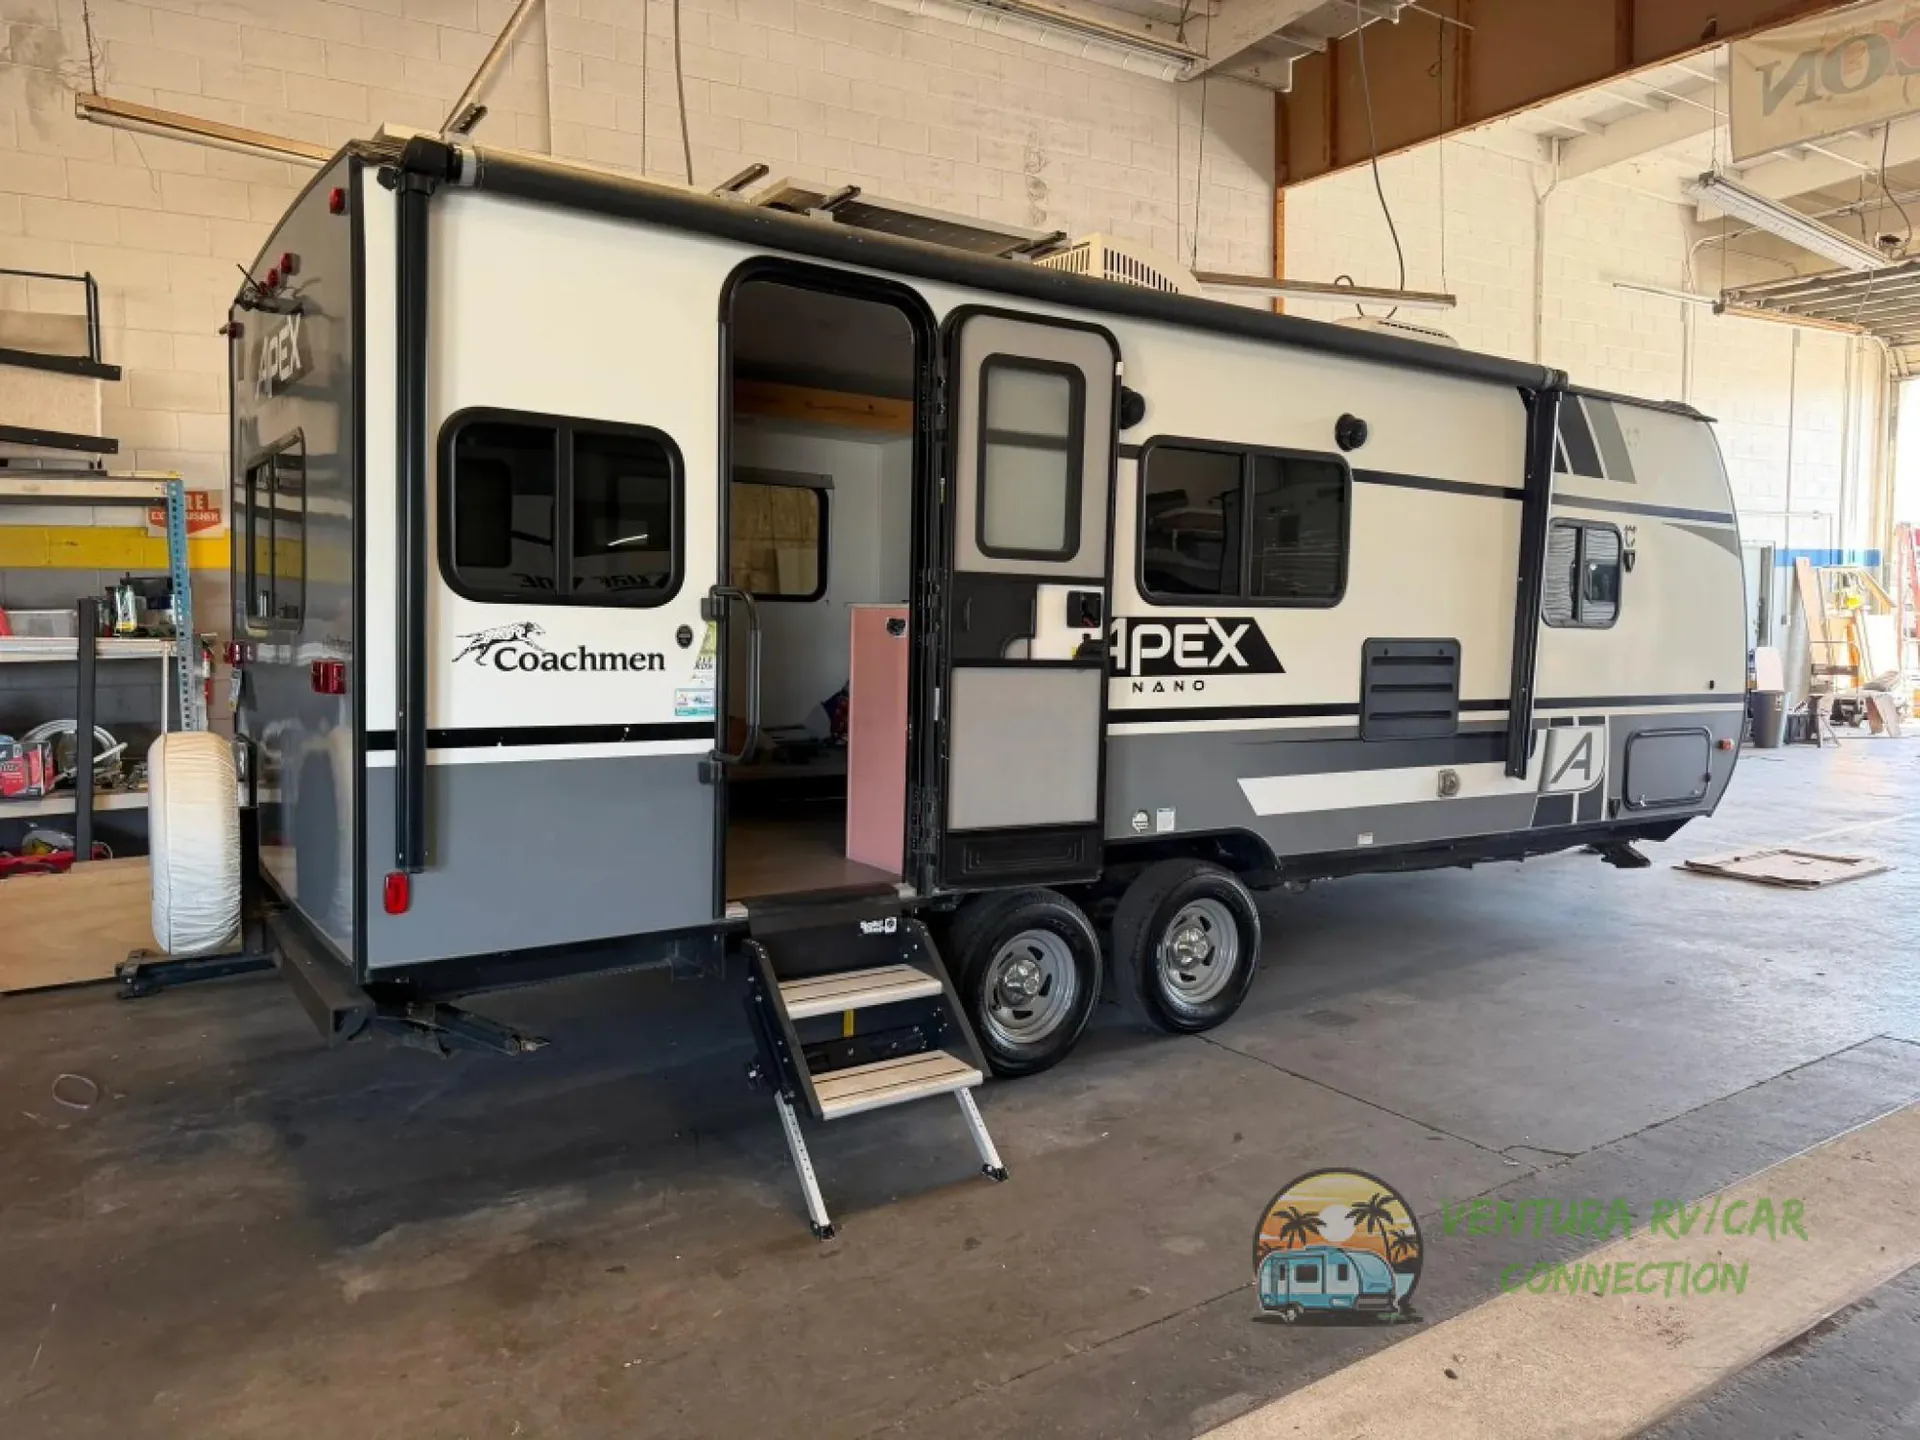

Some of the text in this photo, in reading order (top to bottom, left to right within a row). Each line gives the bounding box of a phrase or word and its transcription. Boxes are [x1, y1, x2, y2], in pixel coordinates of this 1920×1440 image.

[254, 312, 303, 402] APEX
[493, 644, 666, 672] Coachmen
[1132, 680, 1205, 693] NANO
